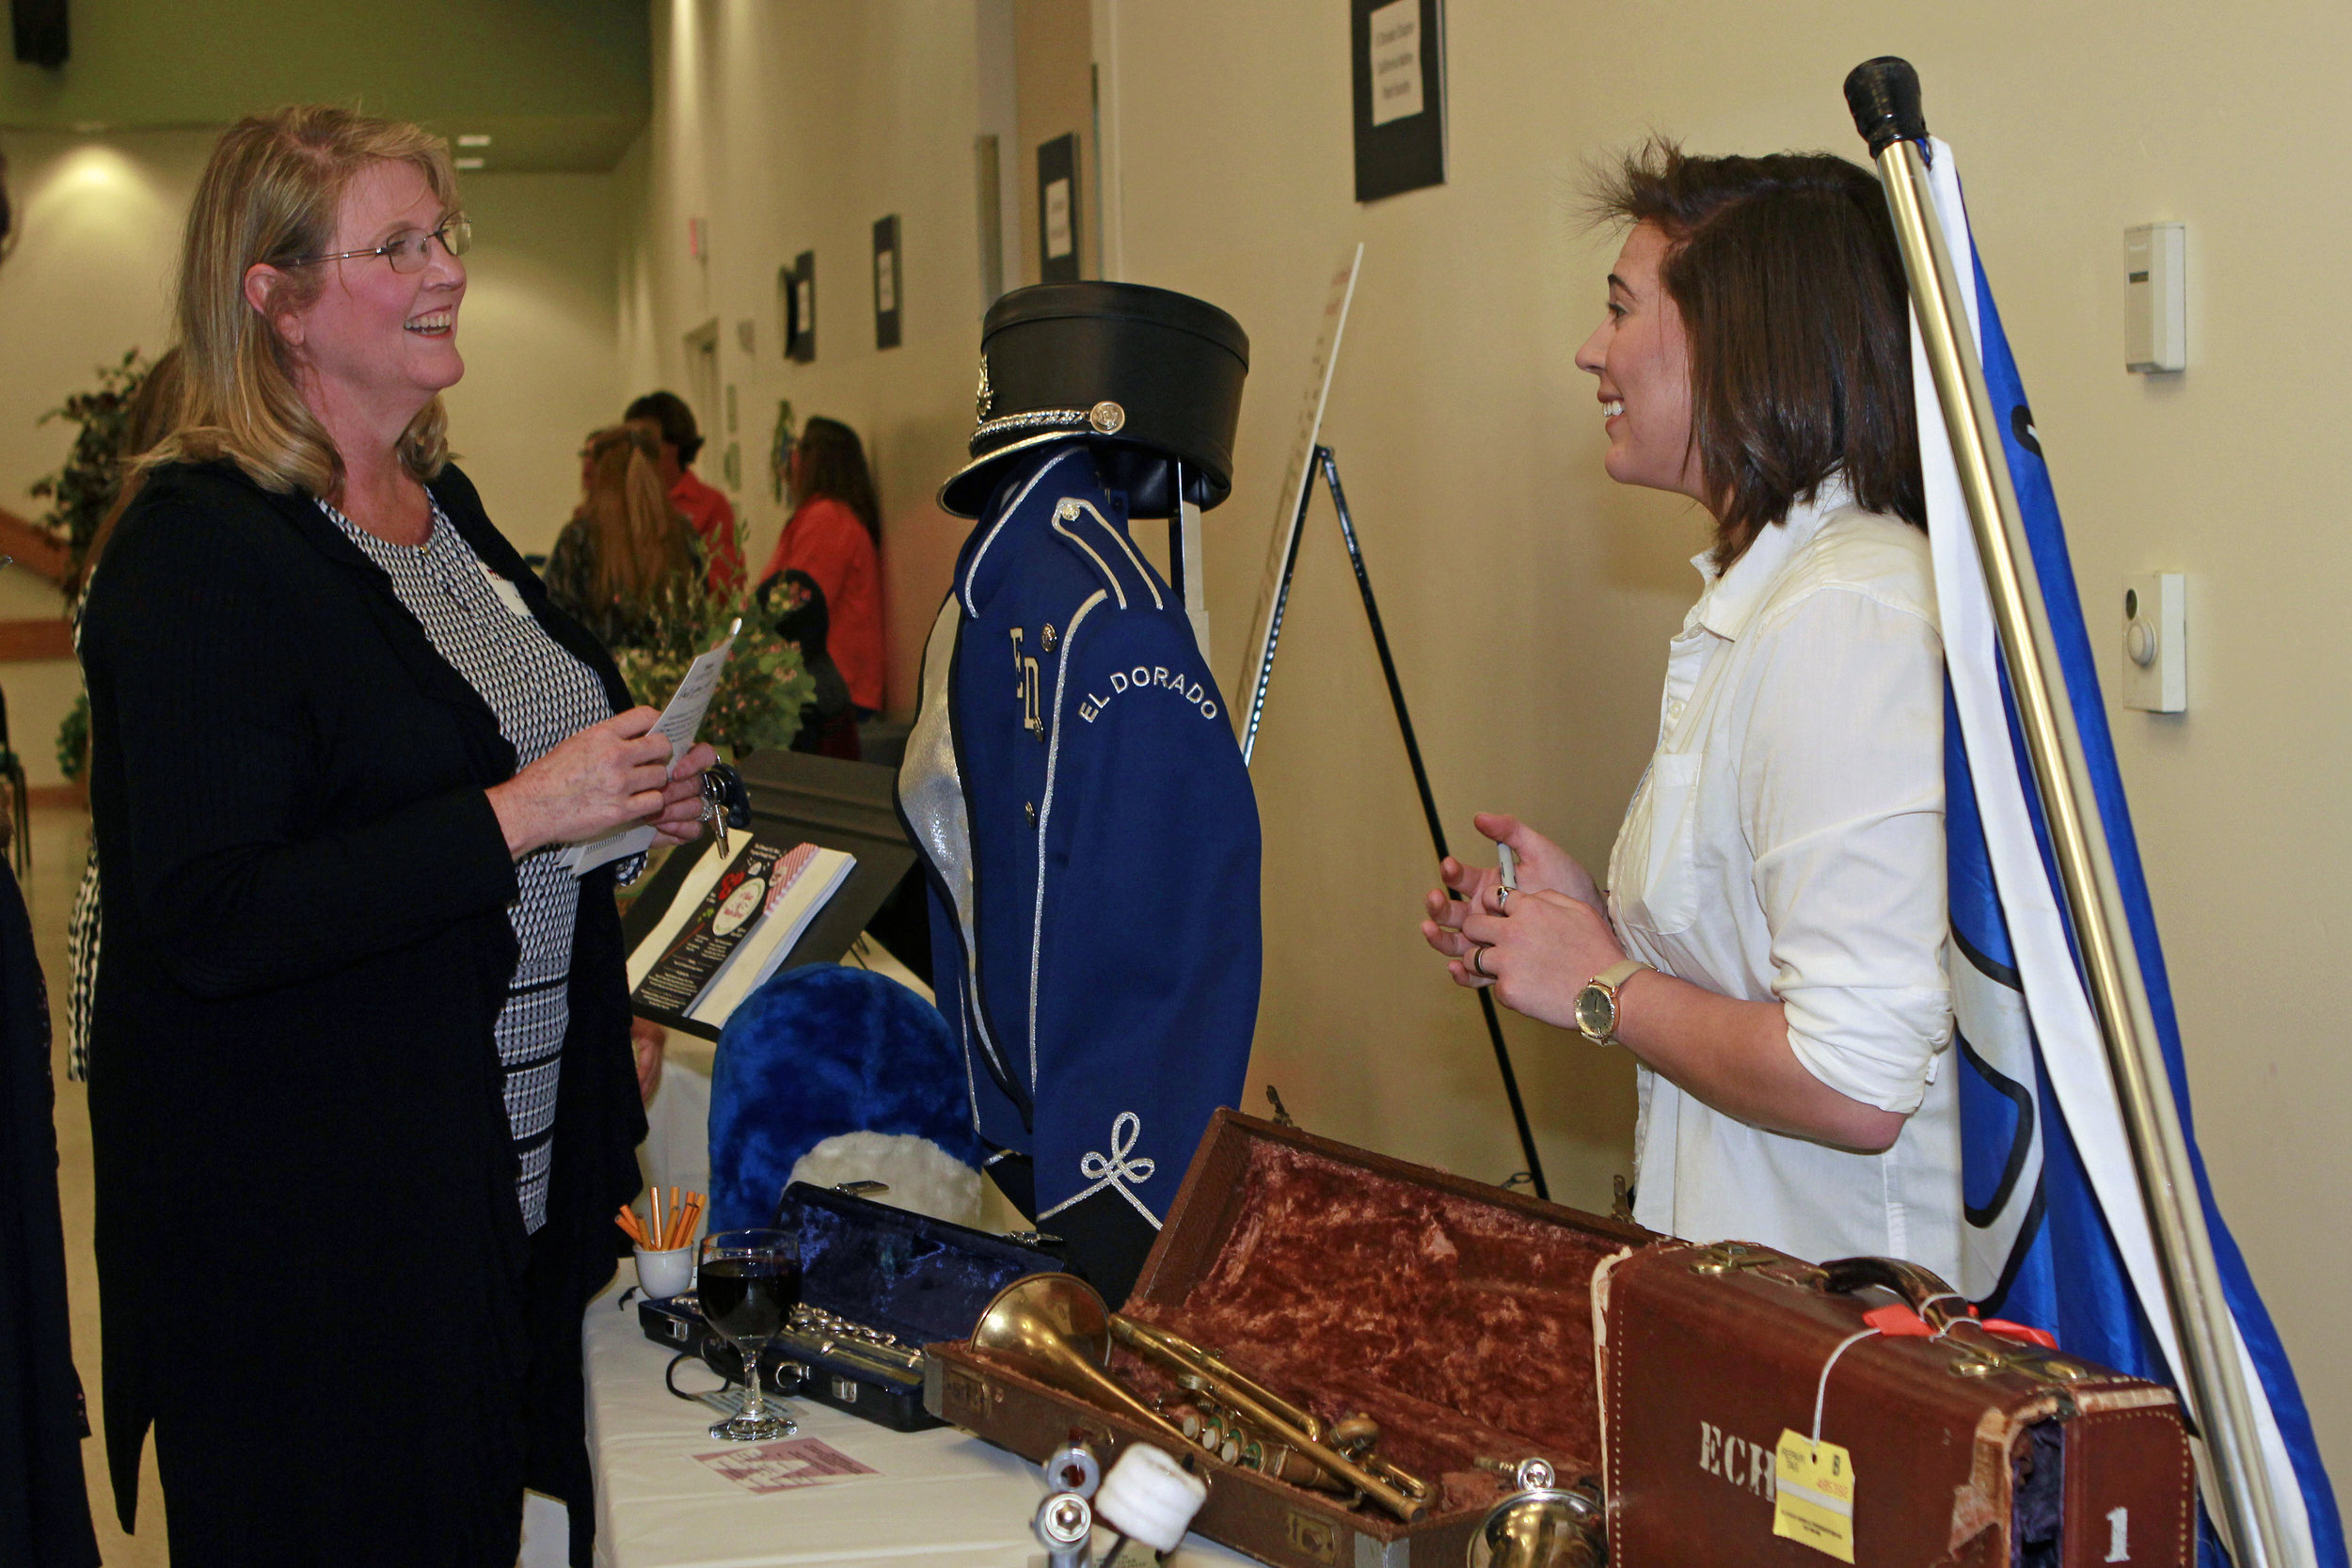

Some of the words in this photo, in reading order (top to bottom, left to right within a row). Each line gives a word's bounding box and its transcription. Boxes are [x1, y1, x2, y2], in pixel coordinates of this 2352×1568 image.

[1078, 692, 1110, 723] EL
[1109, 666, 1218, 721] DORADO
[2104, 1506, 2131, 1563] 1
